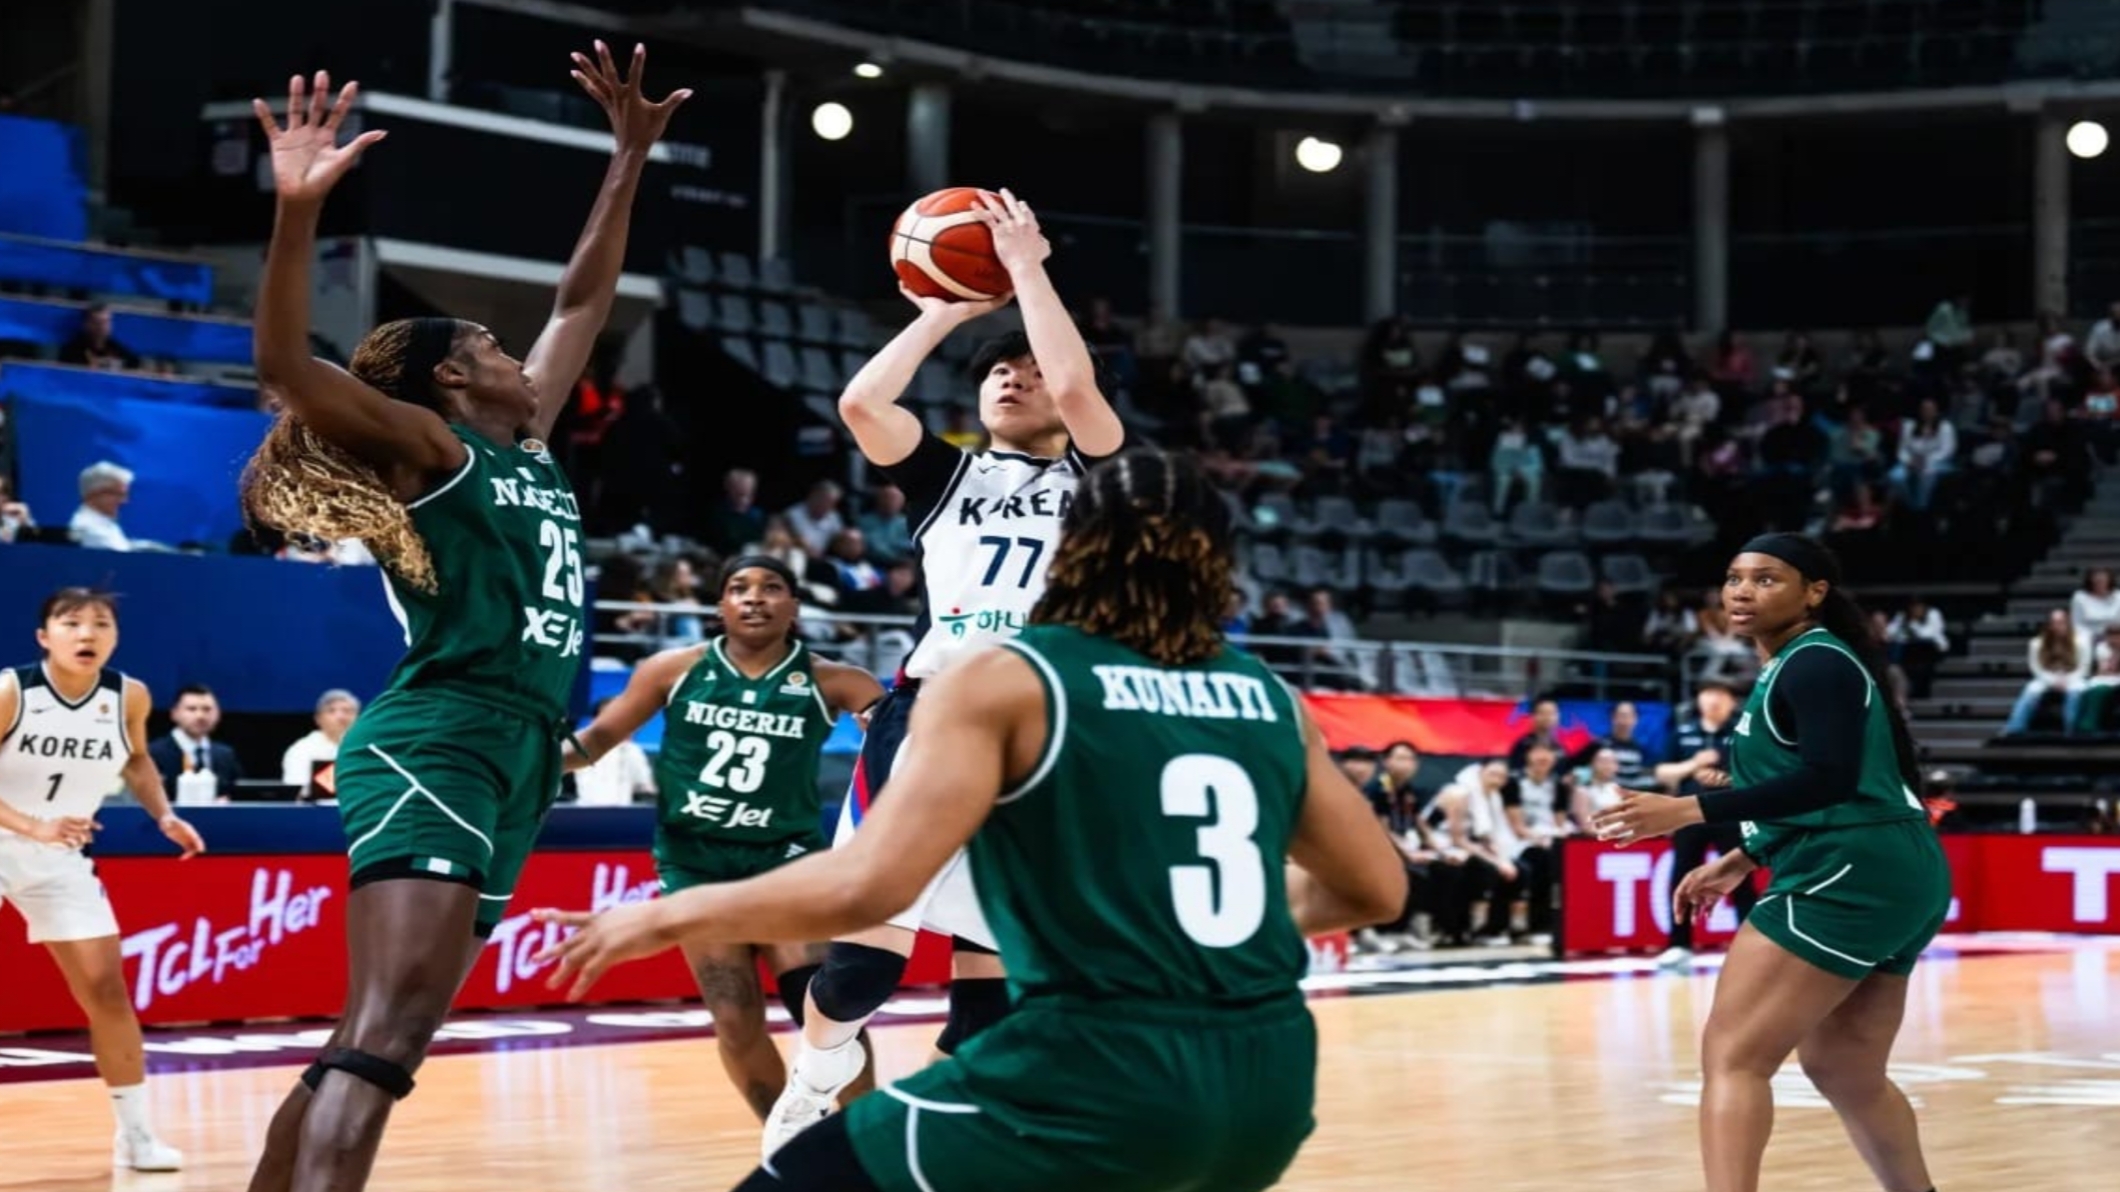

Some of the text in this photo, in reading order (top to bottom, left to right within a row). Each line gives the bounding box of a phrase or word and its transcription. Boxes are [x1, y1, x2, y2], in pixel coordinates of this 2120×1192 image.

[959, 489, 1074, 526] KREA
[539, 519, 584, 607] 25
[979, 536, 1044, 589] 77
[684, 700, 806, 739] NIGERIA
[1092, 665, 1278, 722] KUNAIYI
[18, 733, 113, 761] KOREA
[699, 730, 771, 793] 23
[46, 773, 64, 801] 1
[1160, 753, 1266, 948] 3
[250, 868, 331, 945] Her
